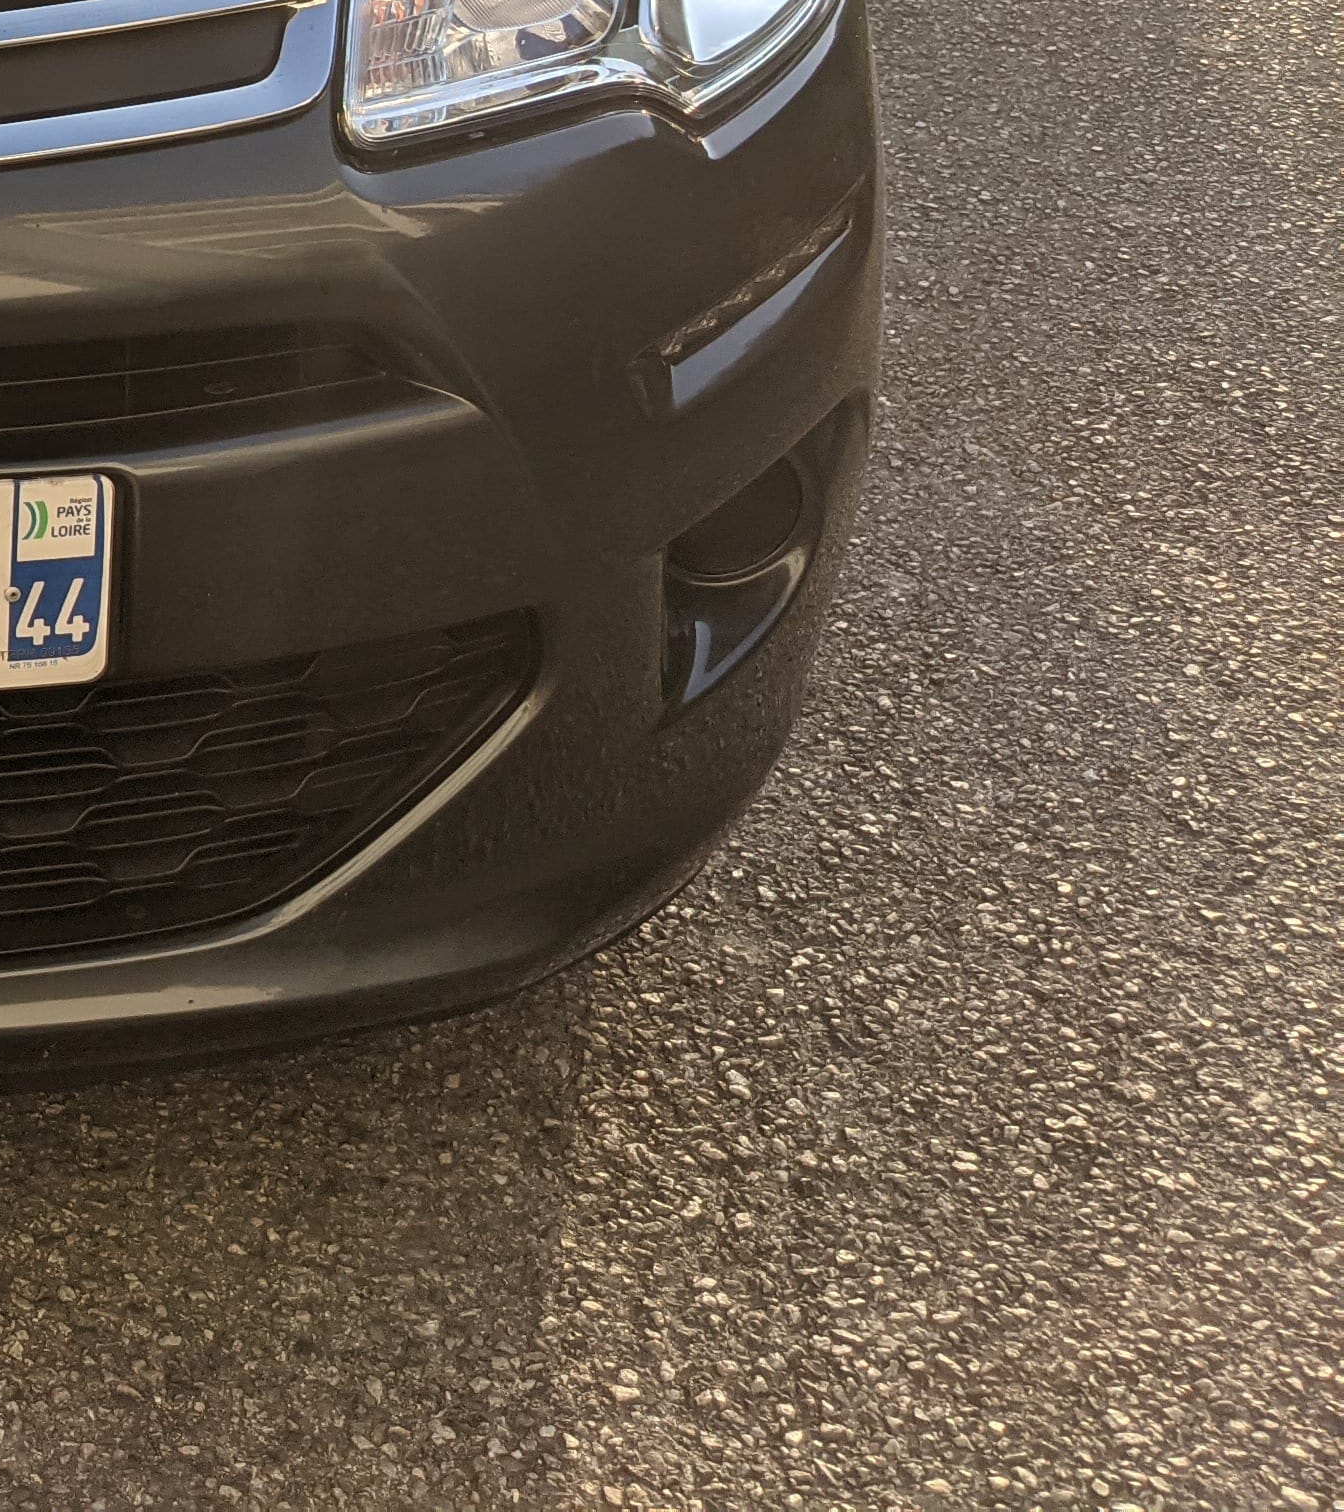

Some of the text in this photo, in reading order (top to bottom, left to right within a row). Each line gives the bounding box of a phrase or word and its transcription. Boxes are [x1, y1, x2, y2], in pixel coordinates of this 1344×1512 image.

[70, 496, 92, 505] Région
[56, 504, 92, 519] PAYS
[50, 523, 92, 538] LOIRE
[15, 577, 90, 646] 44
